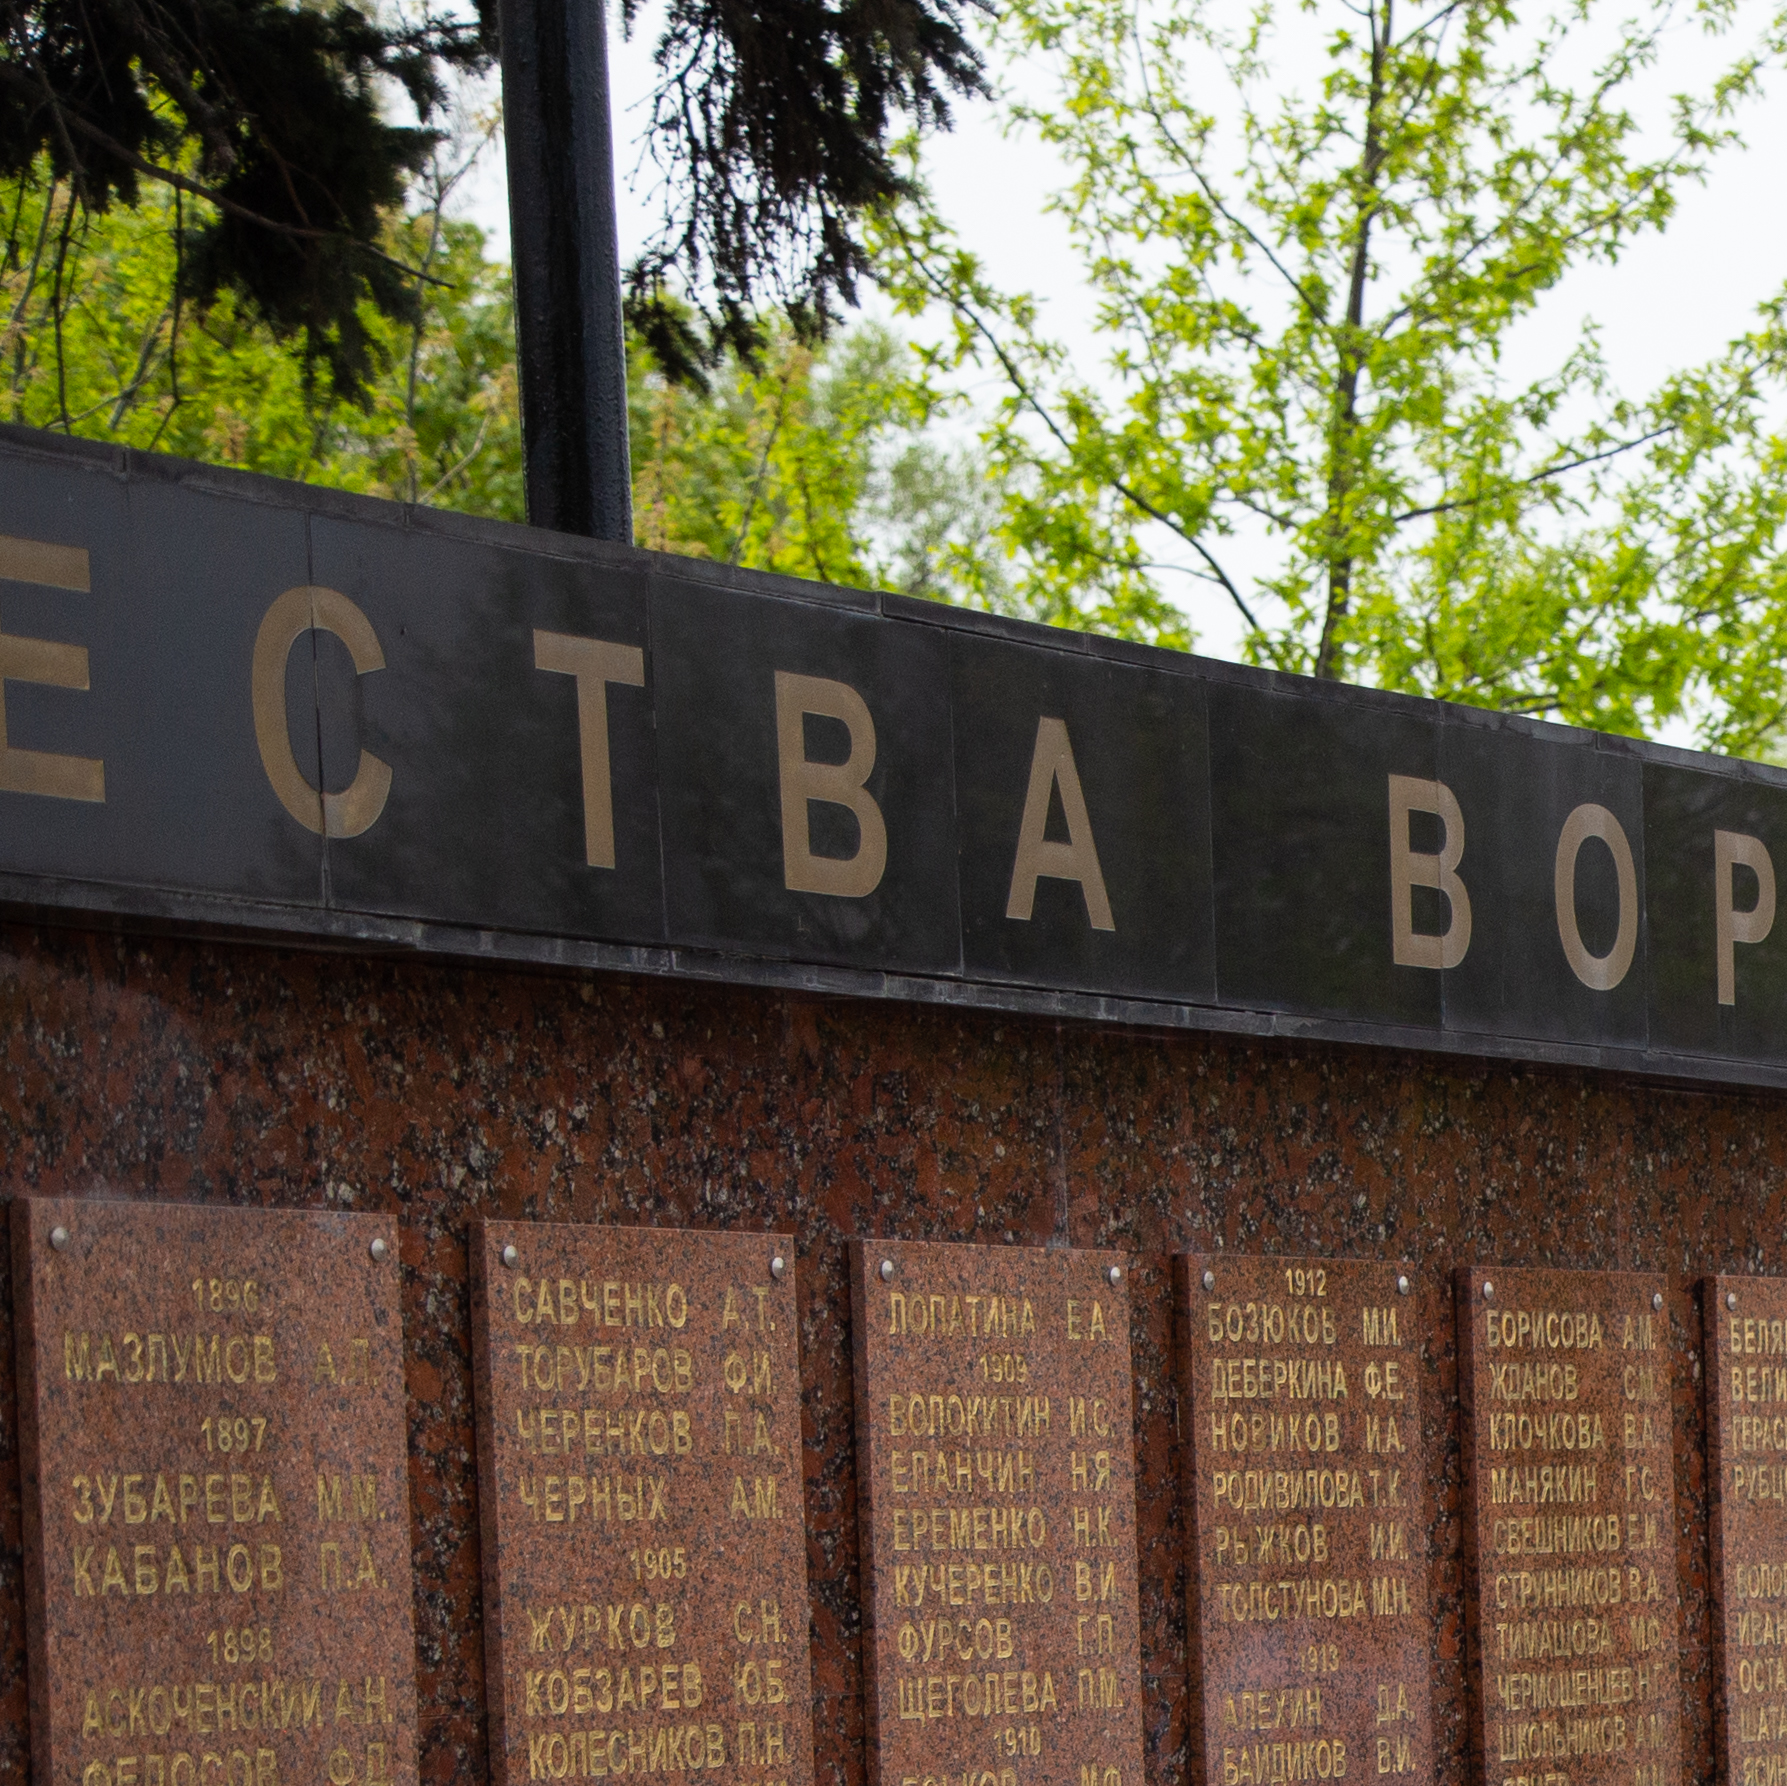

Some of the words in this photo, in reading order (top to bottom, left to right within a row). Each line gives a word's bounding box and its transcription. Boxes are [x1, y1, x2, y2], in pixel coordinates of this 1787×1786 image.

[192, 1277, 258, 1312] 1896
[514, 1277, 689, 1328] САВЧЕНКО
[1285, 1268, 1327, 1297] 1912
[64, 1331, 276, 1383] МАЗЛУМОВ
[516, 1344, 693, 1392] ТОРУБАРОВ
[201, 1416, 267, 1452] 1897
[517, 1408, 692, 1455] ЧЕРЕНКОВ
[72, 1474, 281, 1524] ЗУБАРЕВА
[520, 1475, 667, 1521] ЧЕРНЫХ
[73, 1543, 283, 1595] КАБАНОВ
[631, 1546, 686, 1580] 1905
[207, 1627, 273, 1663] 1898
[527, 1602, 676, 1651] ЖУРКОВ
[525, 1662, 702, 1716] КОБЗАРЕВ
[529, 1724, 725, 1779] КОЛЕСНИКОВ
[994, 1726, 1042, 1755] 1910
